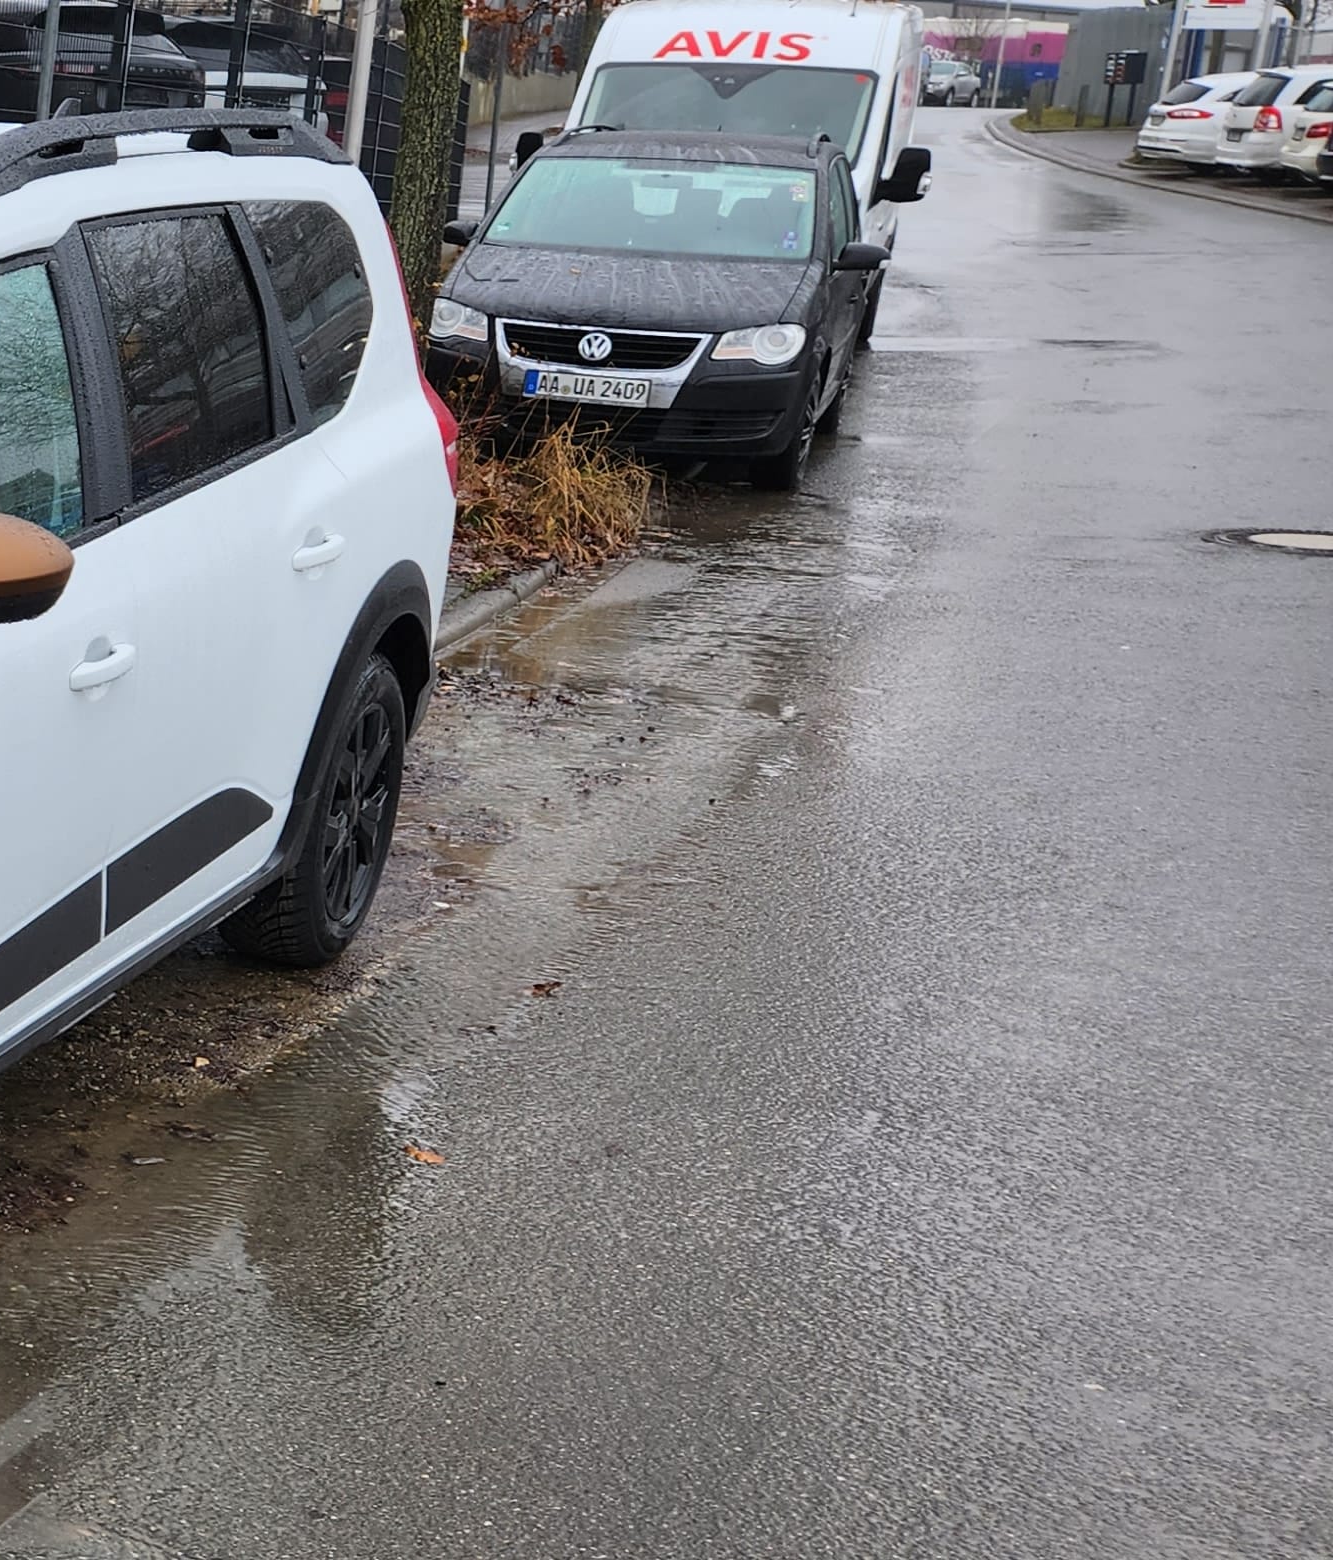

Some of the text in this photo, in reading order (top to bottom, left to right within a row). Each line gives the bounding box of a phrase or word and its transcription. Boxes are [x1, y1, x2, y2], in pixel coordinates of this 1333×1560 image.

[652, 30, 815, 62] AVIS
[538, 374, 646, 401] AA UA 2409
